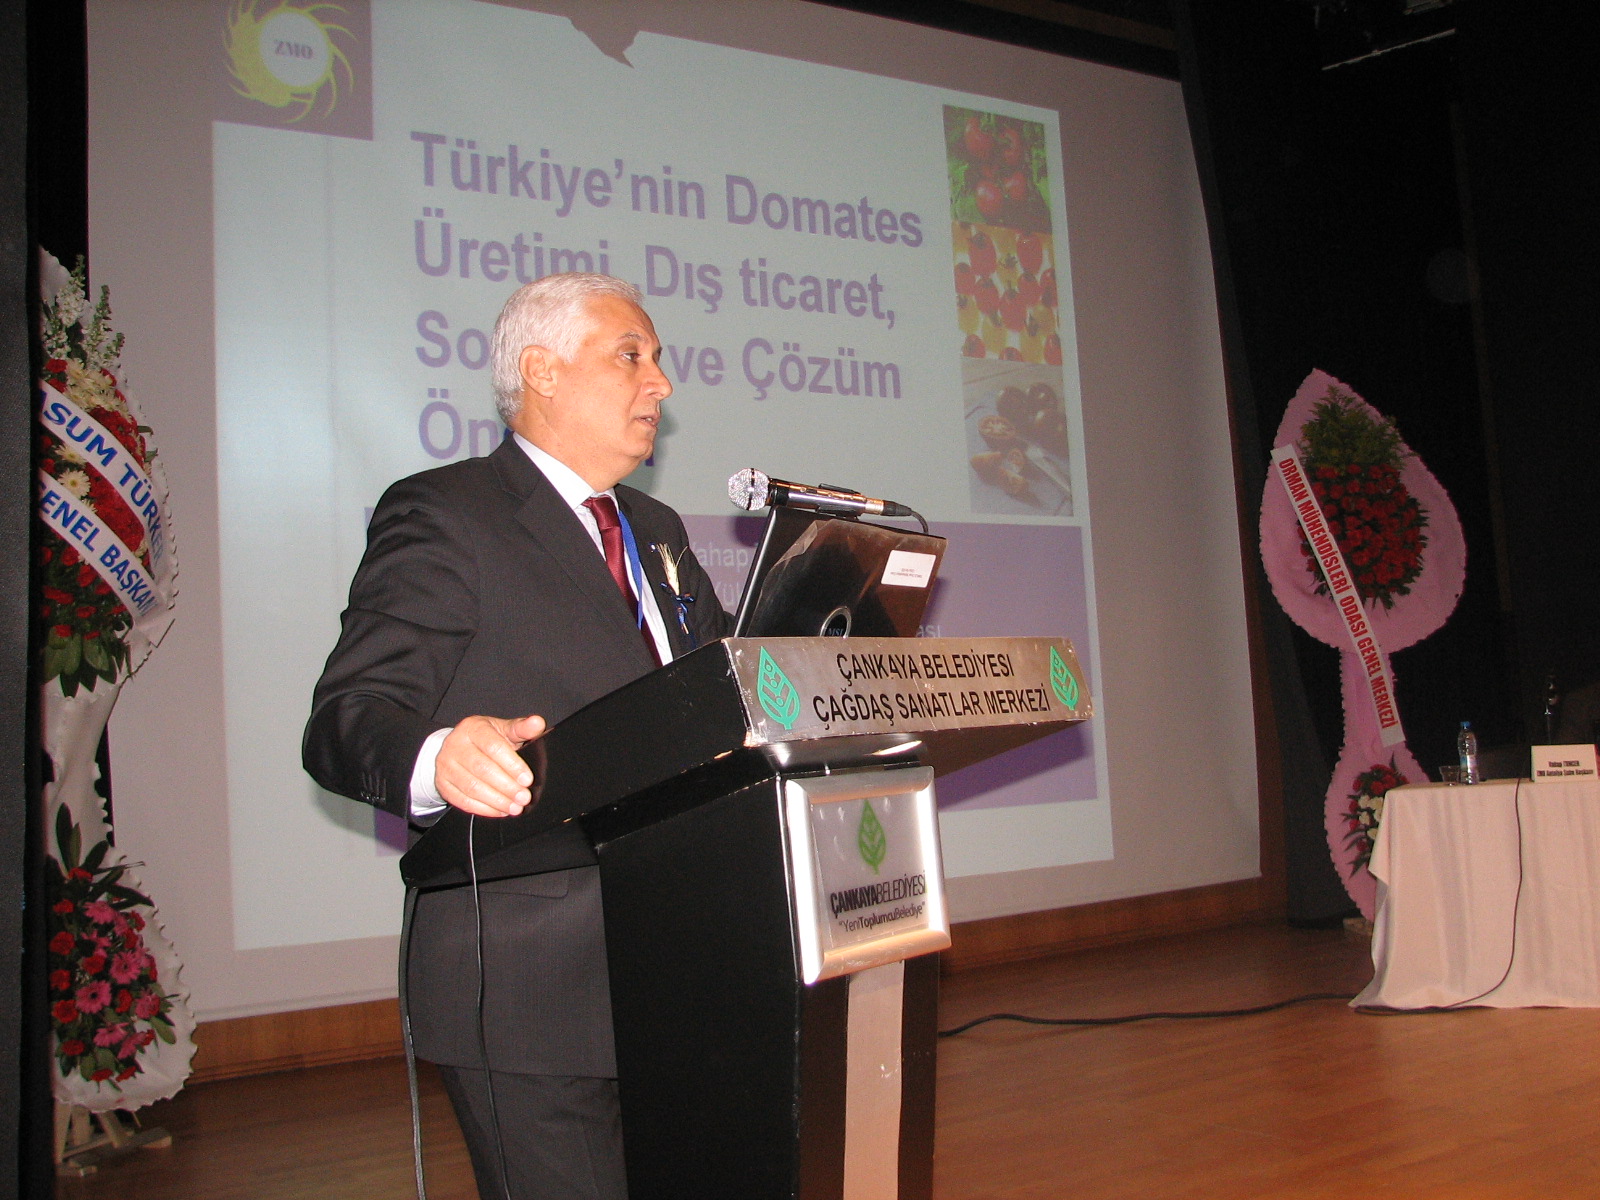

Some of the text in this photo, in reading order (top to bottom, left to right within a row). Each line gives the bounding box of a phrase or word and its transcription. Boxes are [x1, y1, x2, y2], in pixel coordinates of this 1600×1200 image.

[725, 174, 923, 248] Domates
[738, 258, 896, 329] ticaret,
[668, 338, 902, 401] ve Çözüm
[39, 481, 102, 552] ENEL
[1279, 457, 1398, 729] ORMAN MÜHENDİSLERİ ODASI GENEL MERKEZİ
[836, 652, 919, 686] ÇANKAYA
[812, 682, 1050, 731] ÇAĞDAŞ SANATLAR MERKEZİ
